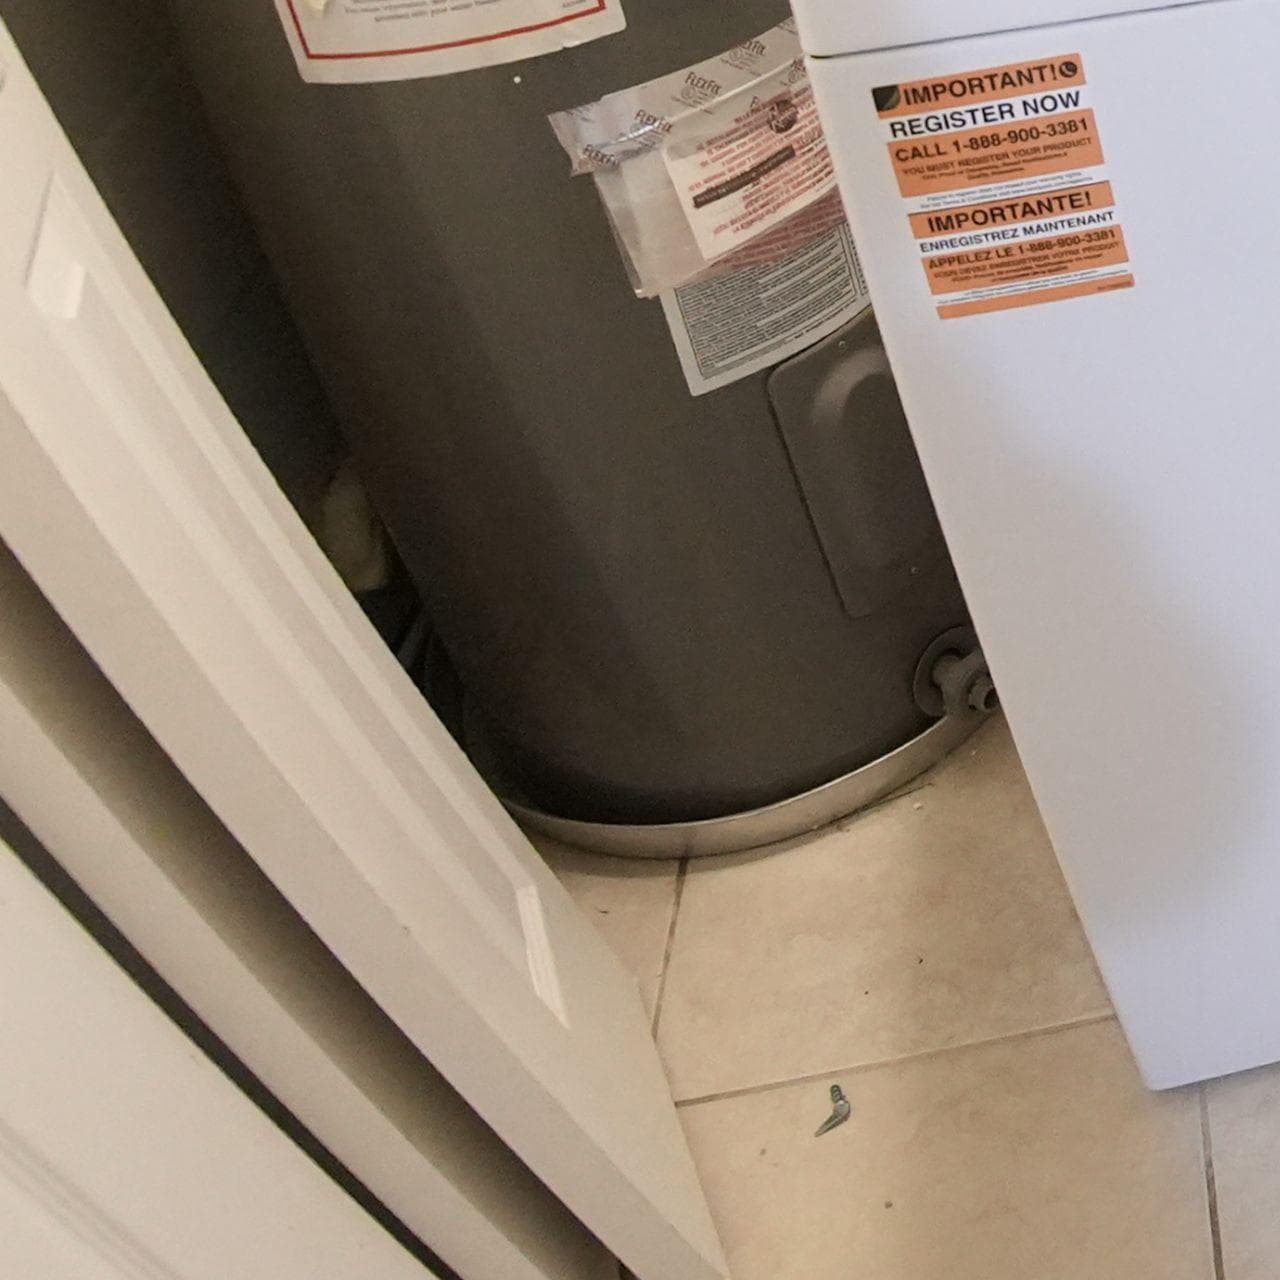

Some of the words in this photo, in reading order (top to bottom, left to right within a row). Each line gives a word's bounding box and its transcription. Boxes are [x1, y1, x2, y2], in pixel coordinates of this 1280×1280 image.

[903, 63, 1058, 106] IMPORTANT!
[889, 102, 1017, 139] REGISTER
[1022, 90, 1081, 117] NOW
[895, 142, 948, 163] CALL
[952, 117, 1089, 154] 1-888-900-3381
[903, 165, 926, 177] YOU
[1011, 146, 1042, 159] YOUR
[1043, 137, 1093, 153] PRODUCT
[919, 228, 1020, 253] ENREGISTREZ
[1023, 211, 1115, 236] MAINTENANT
[927, 190, 1093, 233] IMPORTANTE!
[928, 251, 993, 269] APPELEZ
[995, 247, 1015, 258] LE
[1018, 228, 1116, 256] 1-888-900-3381
